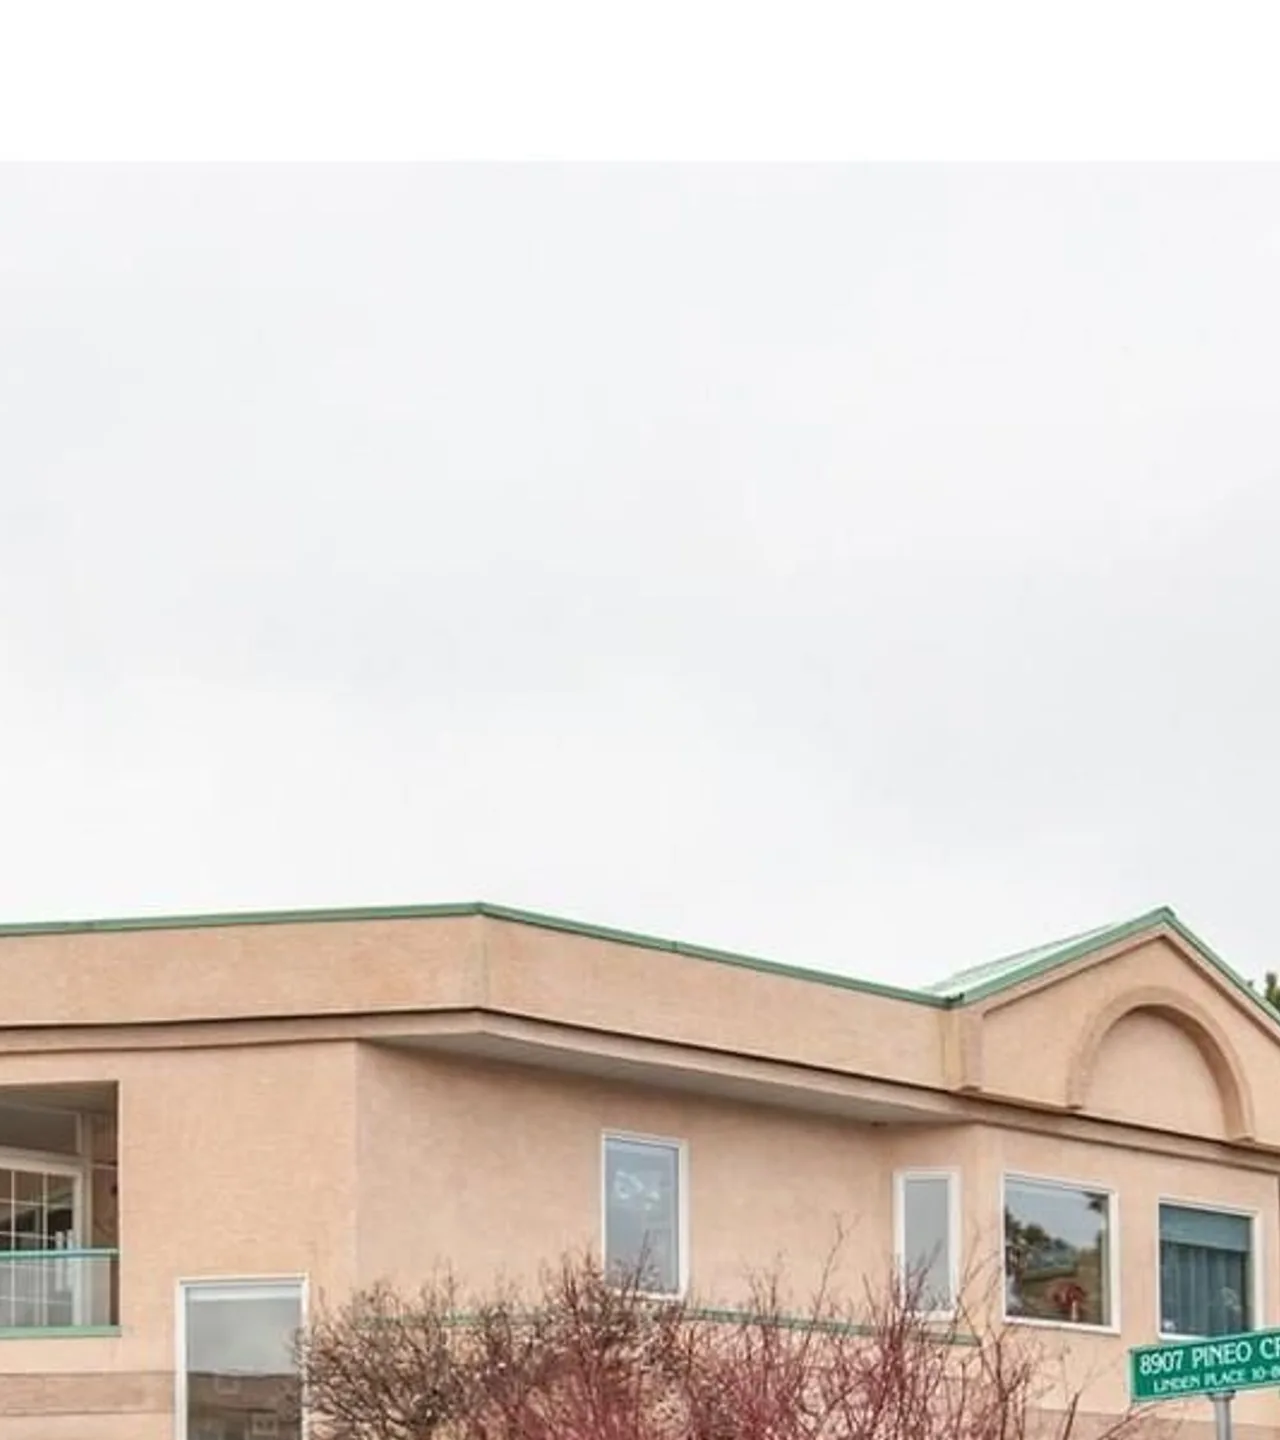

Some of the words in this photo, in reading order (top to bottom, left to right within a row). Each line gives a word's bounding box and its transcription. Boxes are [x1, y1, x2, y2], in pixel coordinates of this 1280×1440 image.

[1139, 1350, 1183, 1376] 8907
[1192, 1341, 1252, 1369] PINEO
[1153, 1375, 1200, 1393] LINDEN
[1204, 1368, 1245, 1387] PLACE
